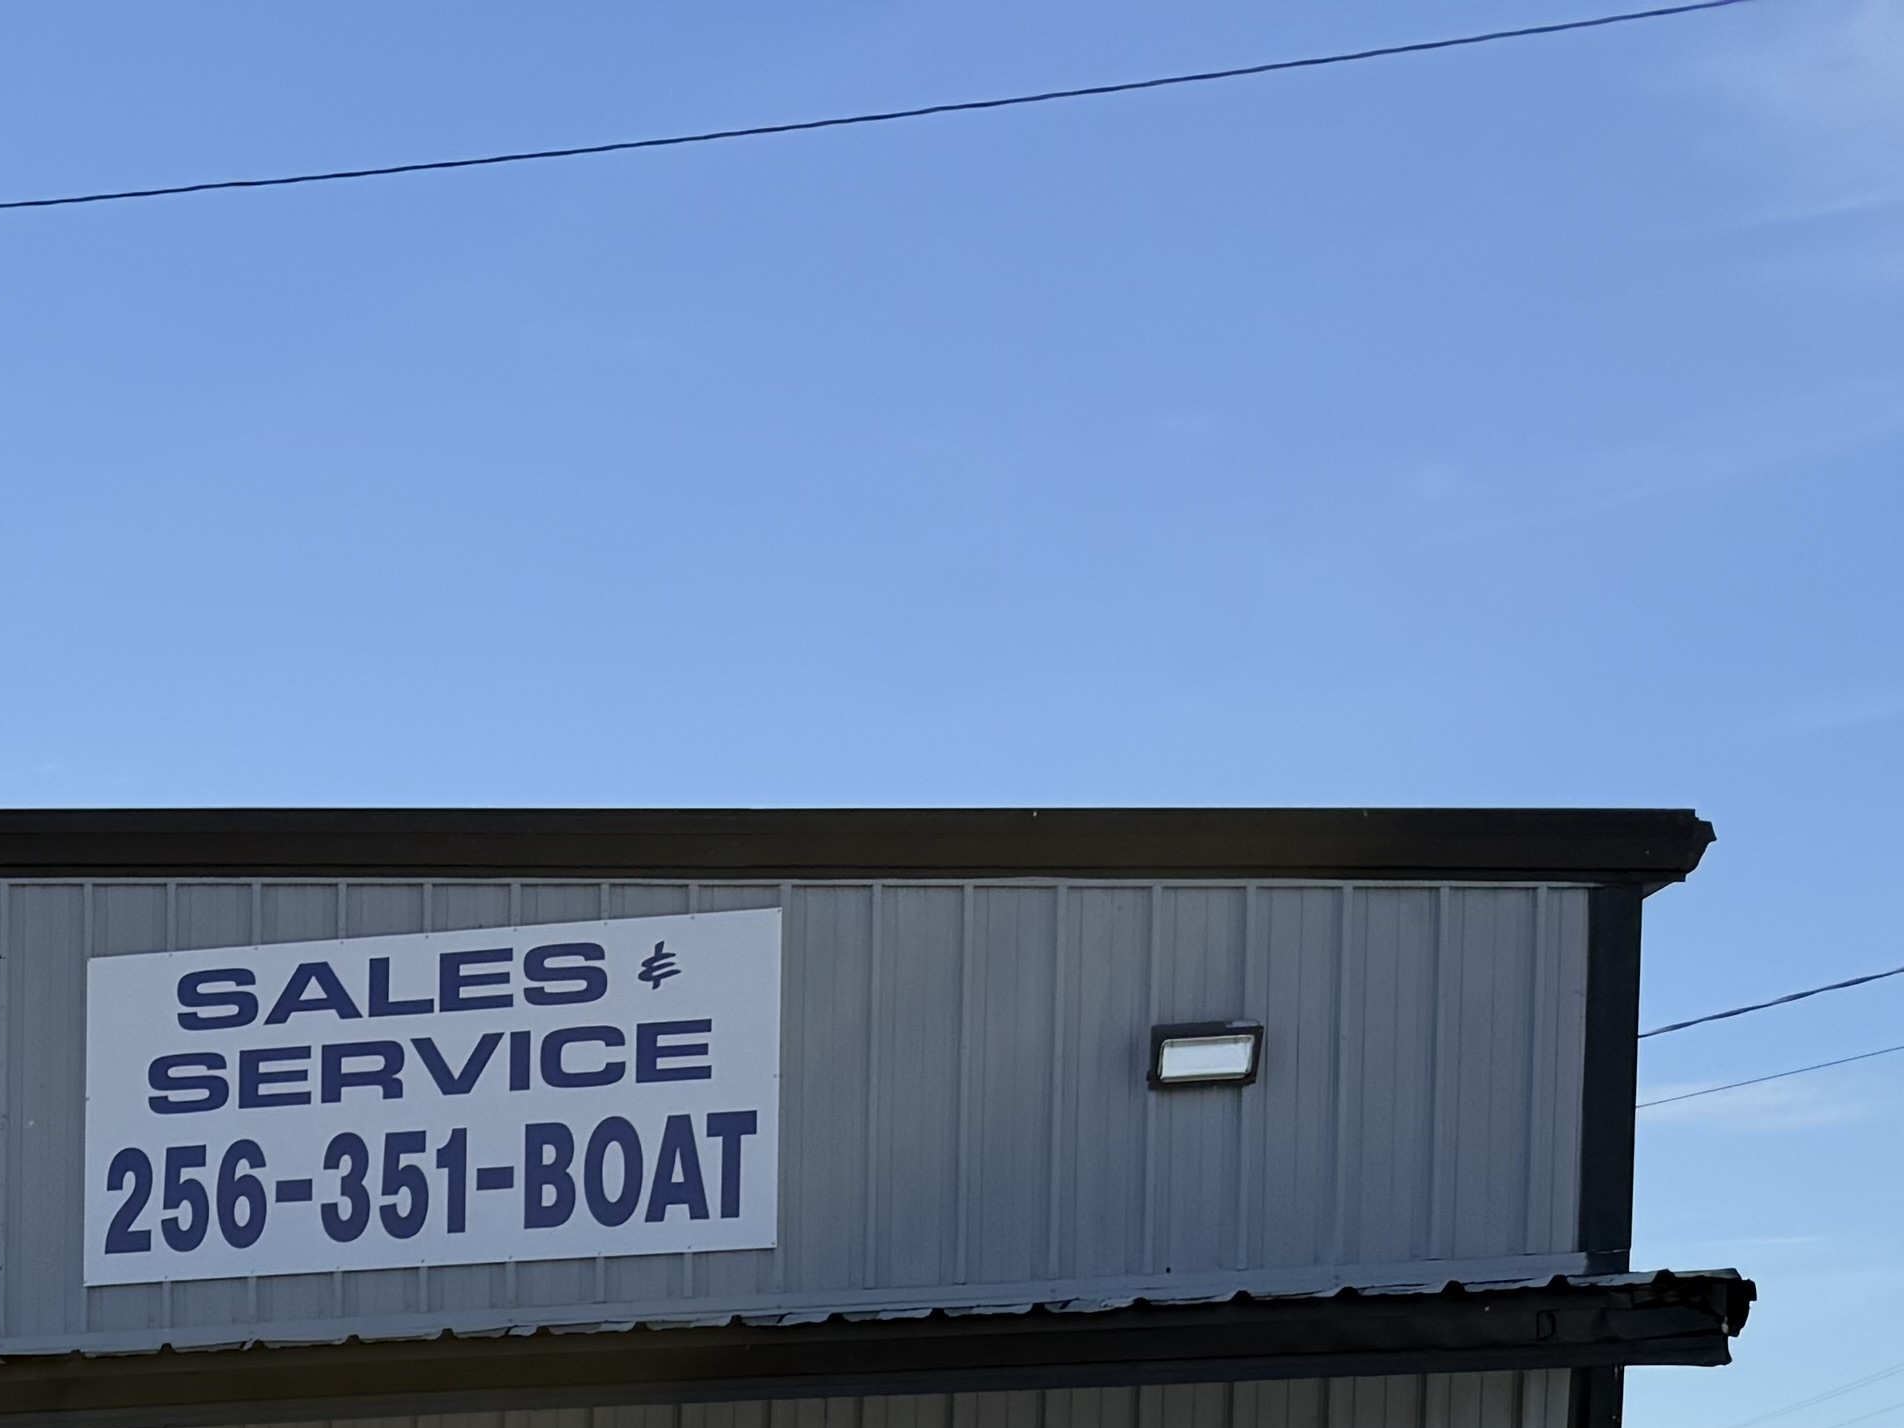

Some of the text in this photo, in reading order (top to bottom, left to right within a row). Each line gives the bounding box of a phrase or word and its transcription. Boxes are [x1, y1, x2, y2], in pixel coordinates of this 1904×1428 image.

[176, 940, 682, 1031] SALES &
[147, 1018, 712, 1115] SERVICE
[104, 1110, 758, 1255] 256-351-BOAT
